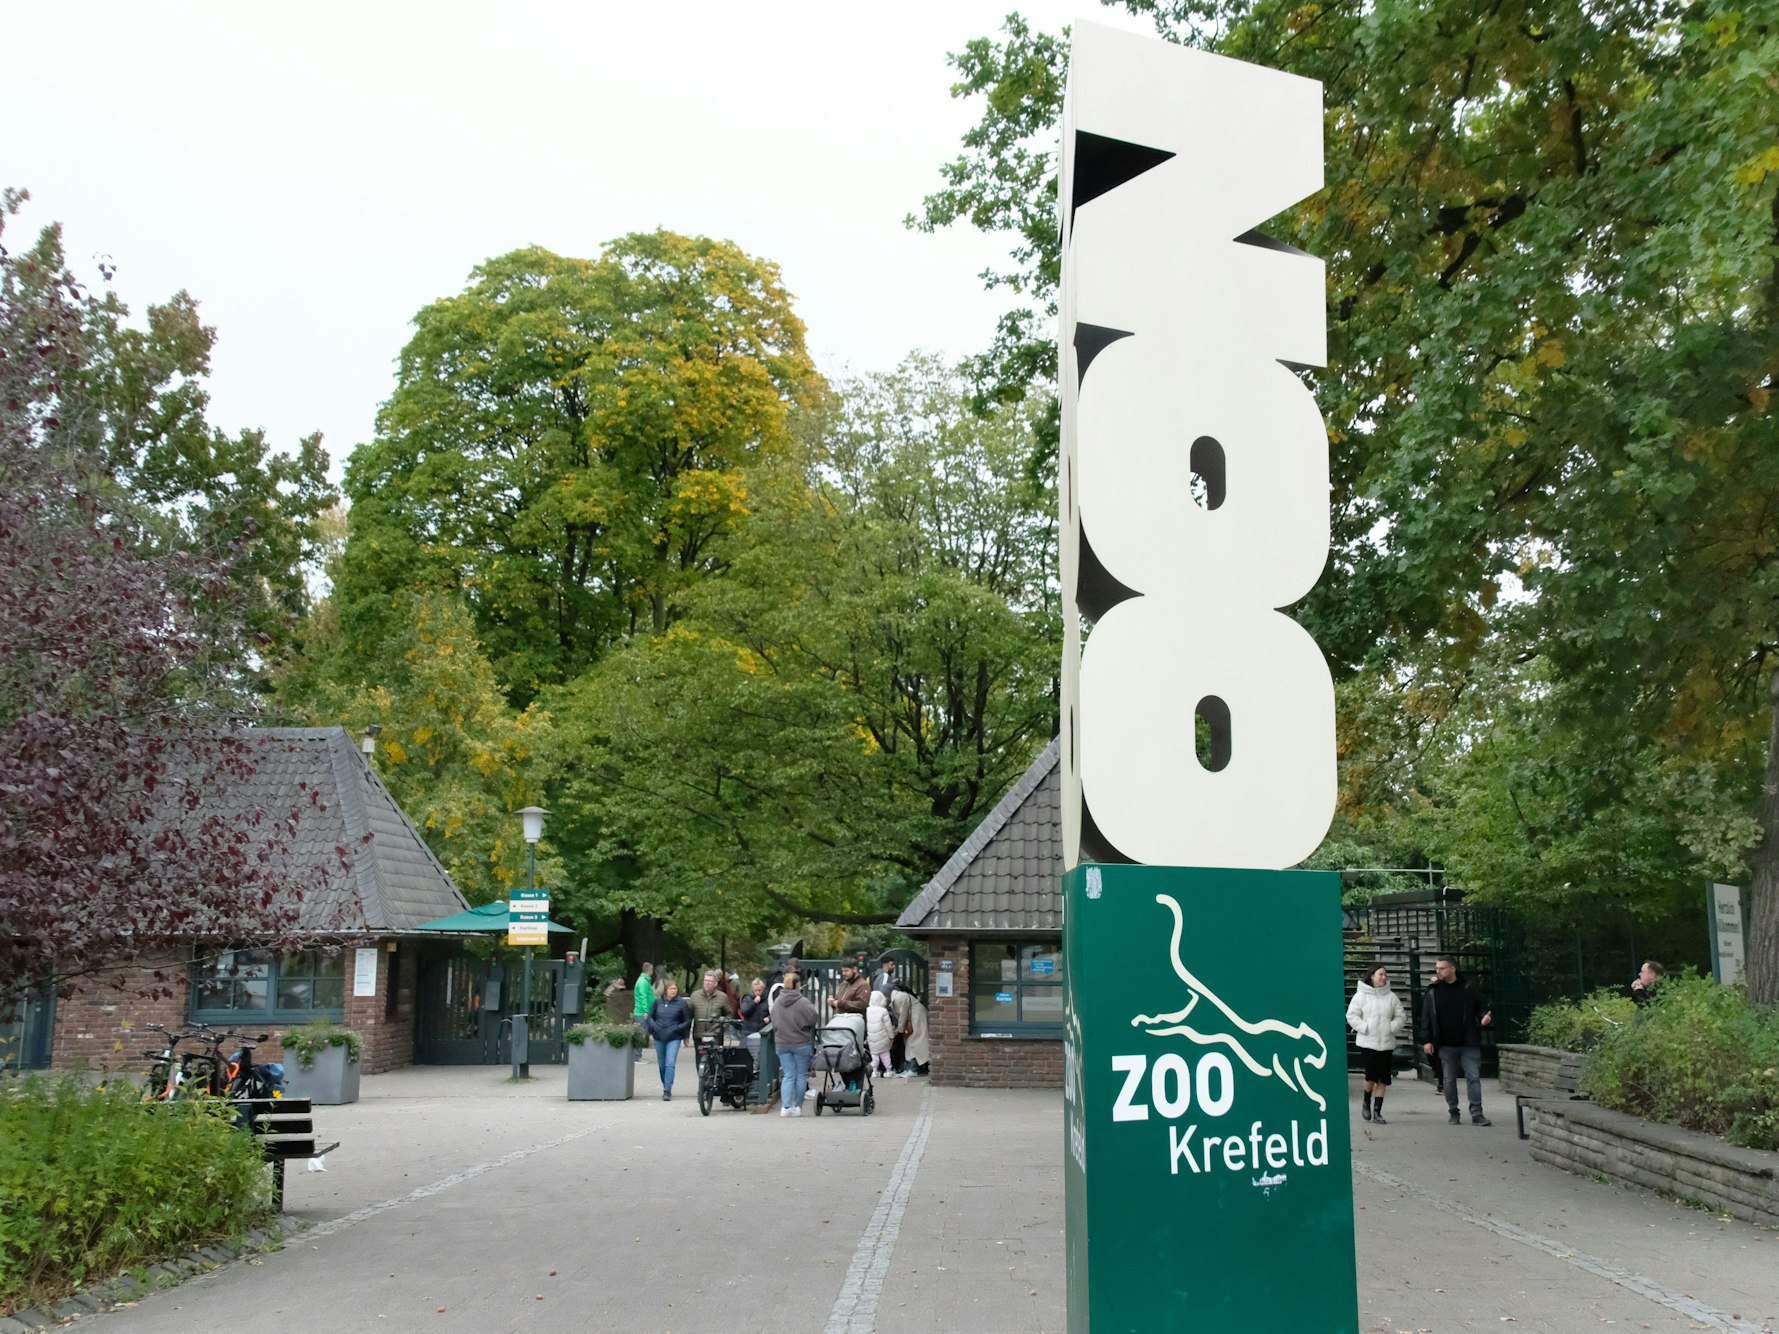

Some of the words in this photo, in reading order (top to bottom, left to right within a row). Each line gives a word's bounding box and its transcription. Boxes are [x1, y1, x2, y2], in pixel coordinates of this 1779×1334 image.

[1074, 19, 1338, 870] ZOO
[1111, 1052, 1234, 1122] ZOO
[1169, 1119, 1329, 1175] Krefeld
